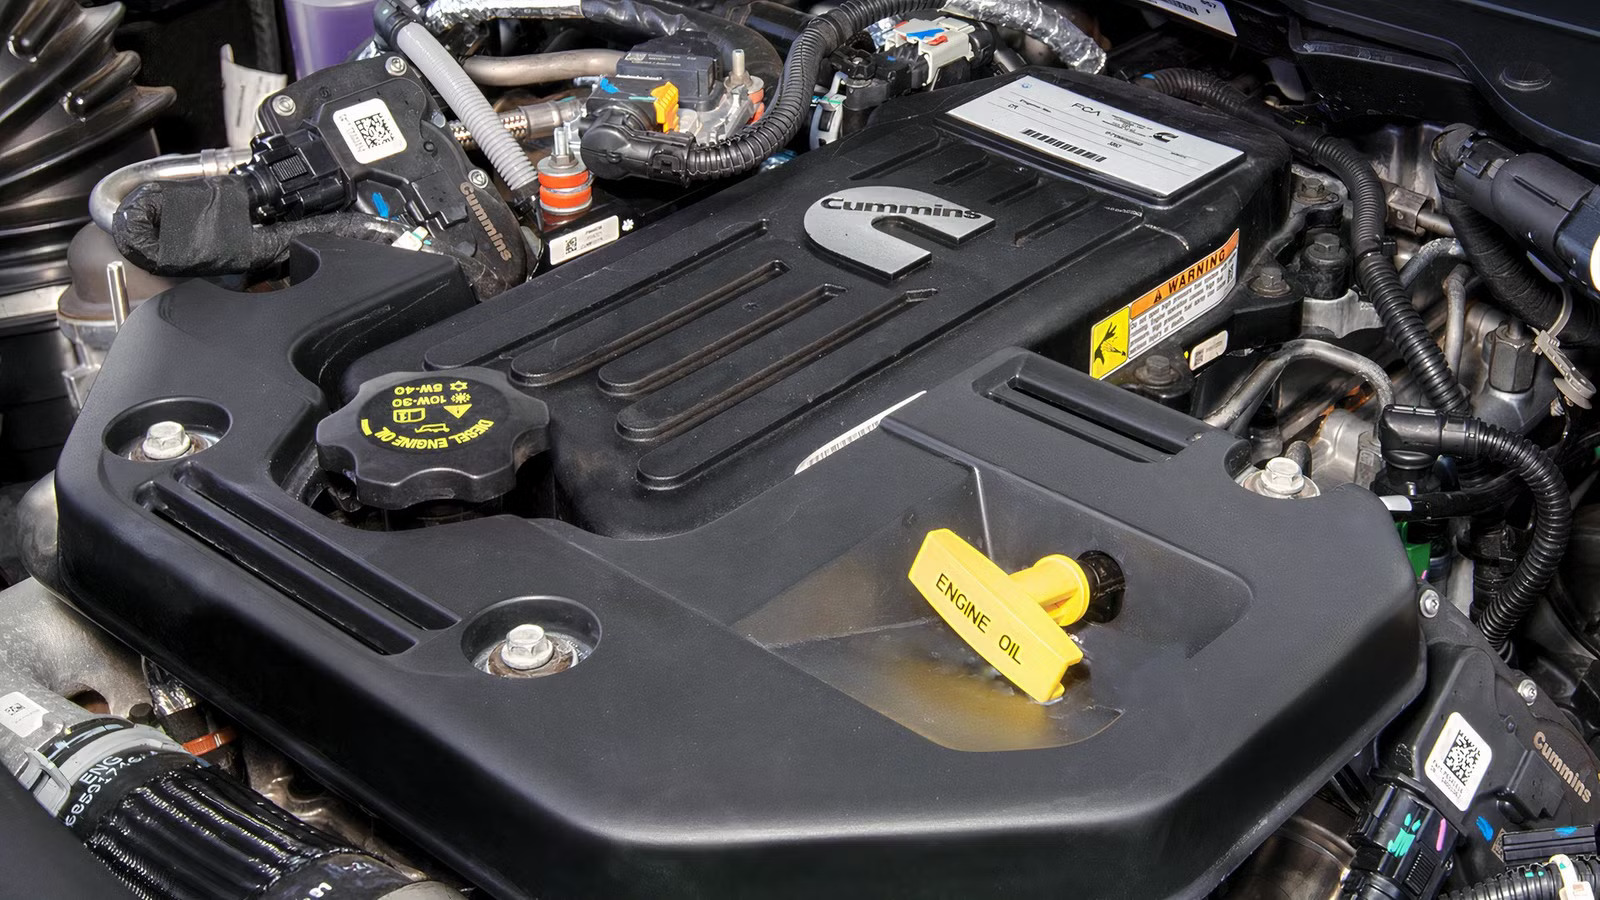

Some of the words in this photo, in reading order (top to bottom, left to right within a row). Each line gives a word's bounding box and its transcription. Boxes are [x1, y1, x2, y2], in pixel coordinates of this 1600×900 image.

[1071, 102, 1101, 116] FCA
[820, 197, 982, 220] Cummins
[460, 181, 512, 262] Cummins
[1168, 249, 1225, 294] WARNING
[391, 395, 447, 408] 10W-30
[394, 383, 443, 396] 5W-40
[374, 426, 397, 442] OIL
[391, 435, 449, 450] ENGINE
[448, 419, 495, 445] DIESEL
[935, 573, 992, 634] ENGINE
[998, 634, 1022, 666] OIL
[79, 755, 123, 785] ENG
[1533, 731, 1592, 804] Cummins
